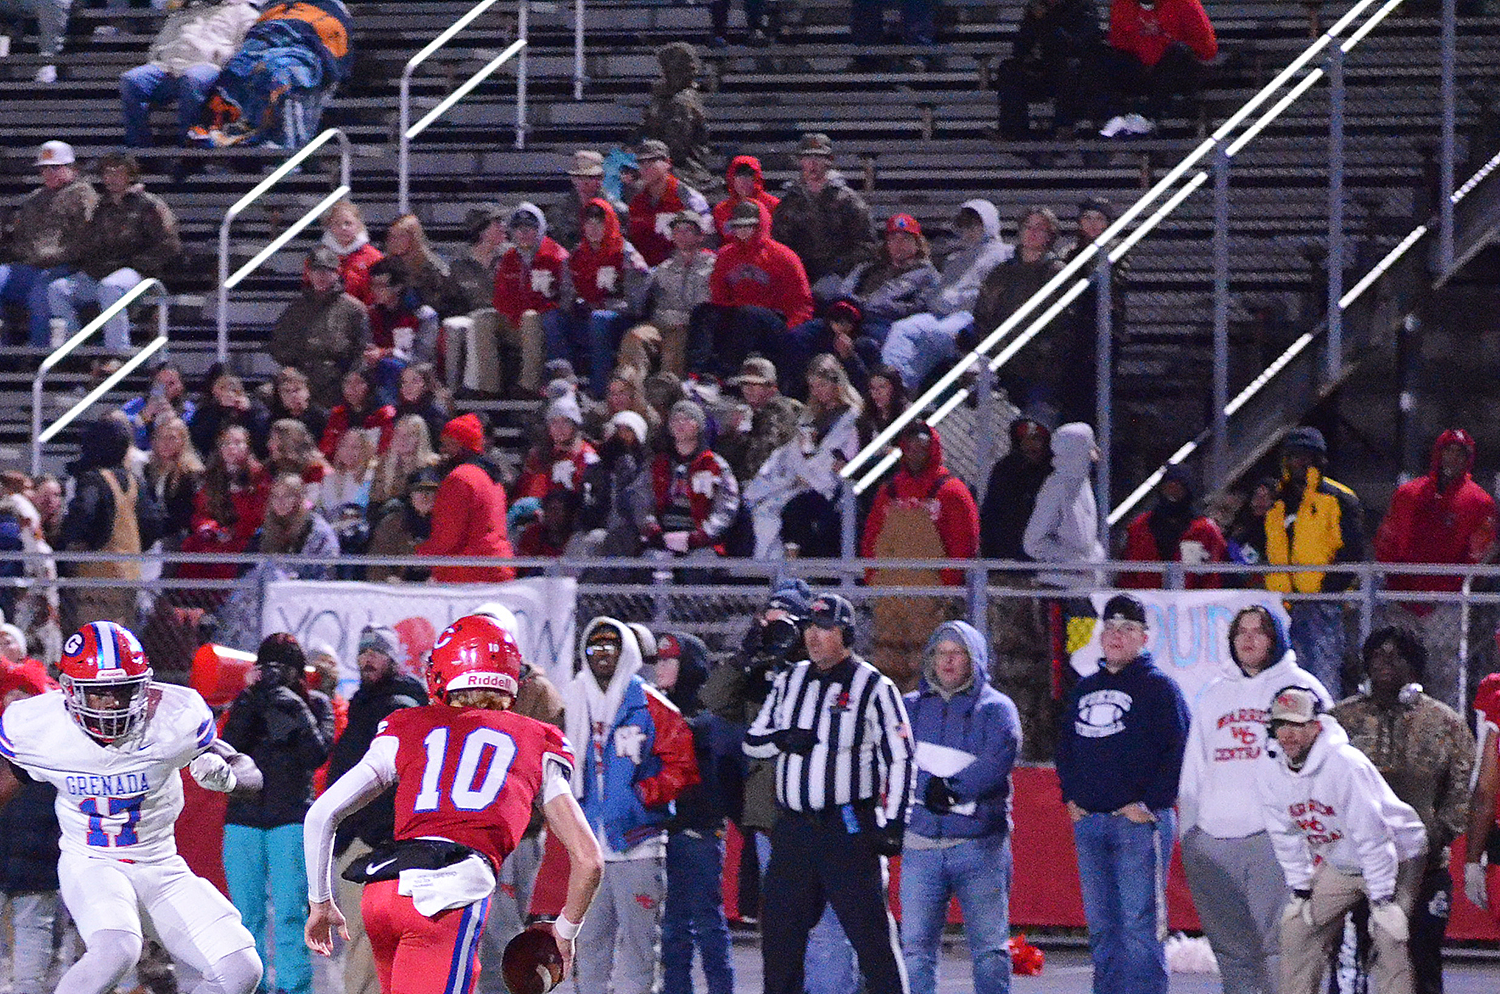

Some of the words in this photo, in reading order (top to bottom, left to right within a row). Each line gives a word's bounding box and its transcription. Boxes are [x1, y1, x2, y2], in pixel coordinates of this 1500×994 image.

[64, 633, 83, 654] G
[488, 643, 500, 653] 10
[467, 674, 512, 689] Riddell
[413, 725, 518, 814] 10
[66, 772, 151, 796] GRENADA
[79, 795, 147, 848] 17
